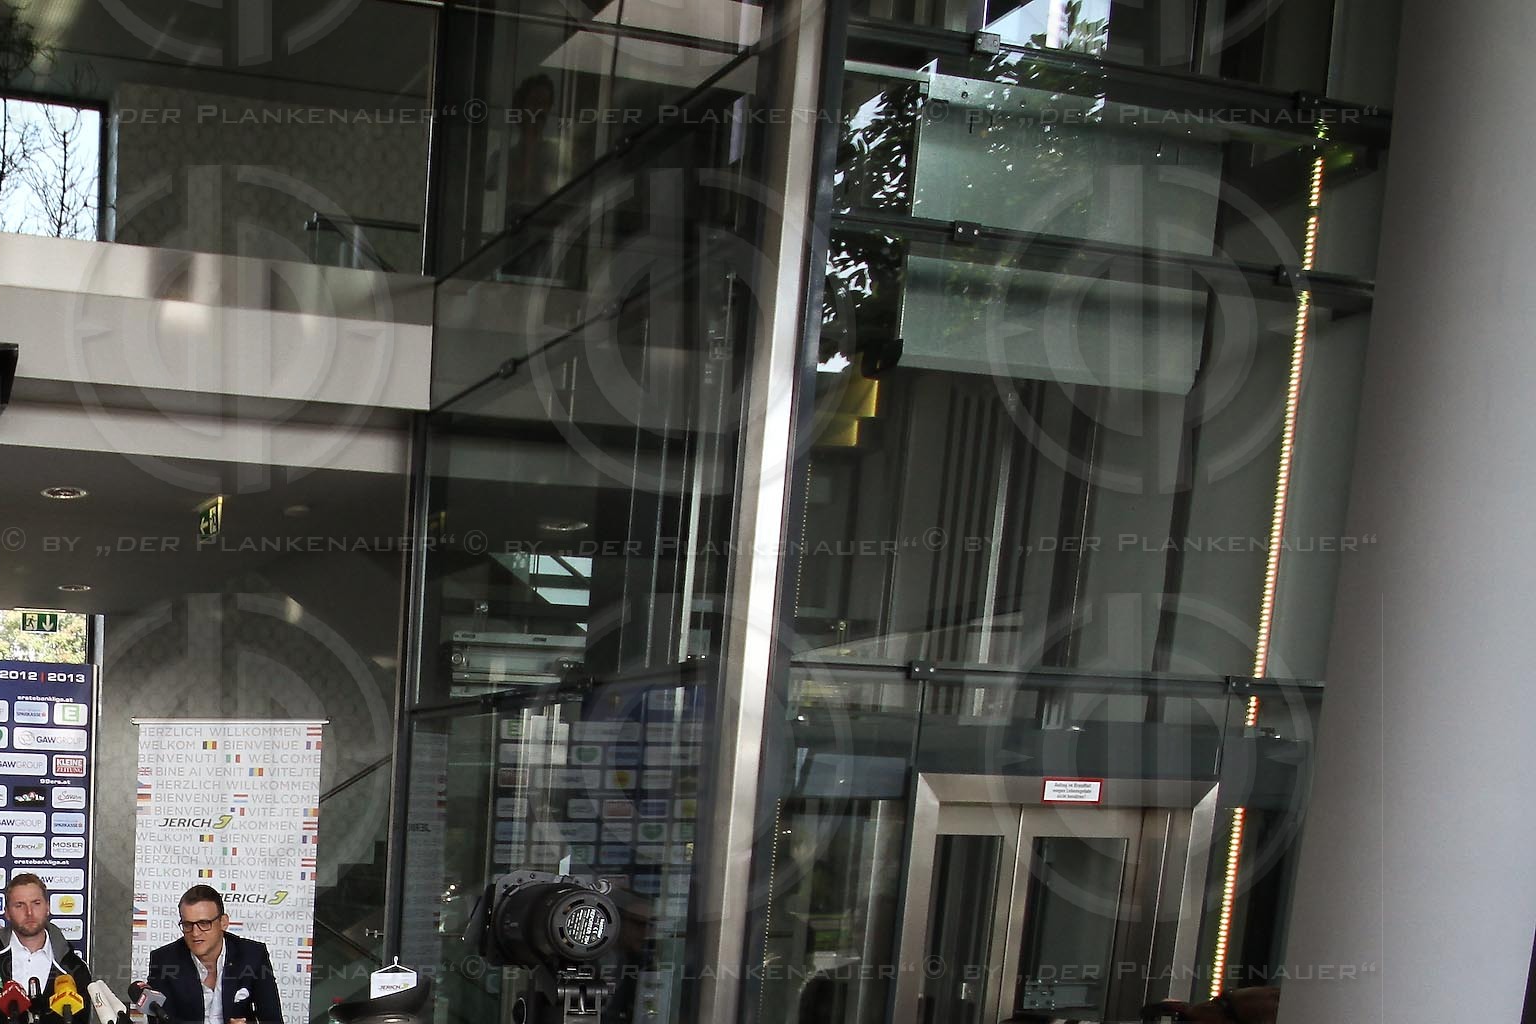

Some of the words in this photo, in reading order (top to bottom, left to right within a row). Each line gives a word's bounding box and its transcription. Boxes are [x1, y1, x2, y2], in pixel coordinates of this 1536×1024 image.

[0, 670, 38, 680] 2012
[48, 672, 85, 683] 2013
[209, 728, 302, 737] WILLKOMMEN
[139, 741, 195, 750] WELKOM
[223, 741, 300, 750] BIENVENUE
[249, 754, 320, 763] WELCOME
[156, 768, 185, 776] BINE
[191, 768, 202, 776] AI
[207, 768, 244, 776] VENIT
[268, 768, 320, 777] VITEJTE
[156, 780, 220, 790] HERZLICH
[226, 781, 319, 790] WILLKOMMEN
[154, 794, 227, 803] BIENVENUE
[252, 794, 319, 803] WELCOME
[248, 807, 300, 816] VITEJTE
[158, 818, 212, 828] JERICH
[205, 857, 296, 867] WILLKOMMEN
[136, 868, 192, 878] WELKOM
[219, 870, 293, 880] BIENVENUE
[246, 922, 313, 932] WELCOME
